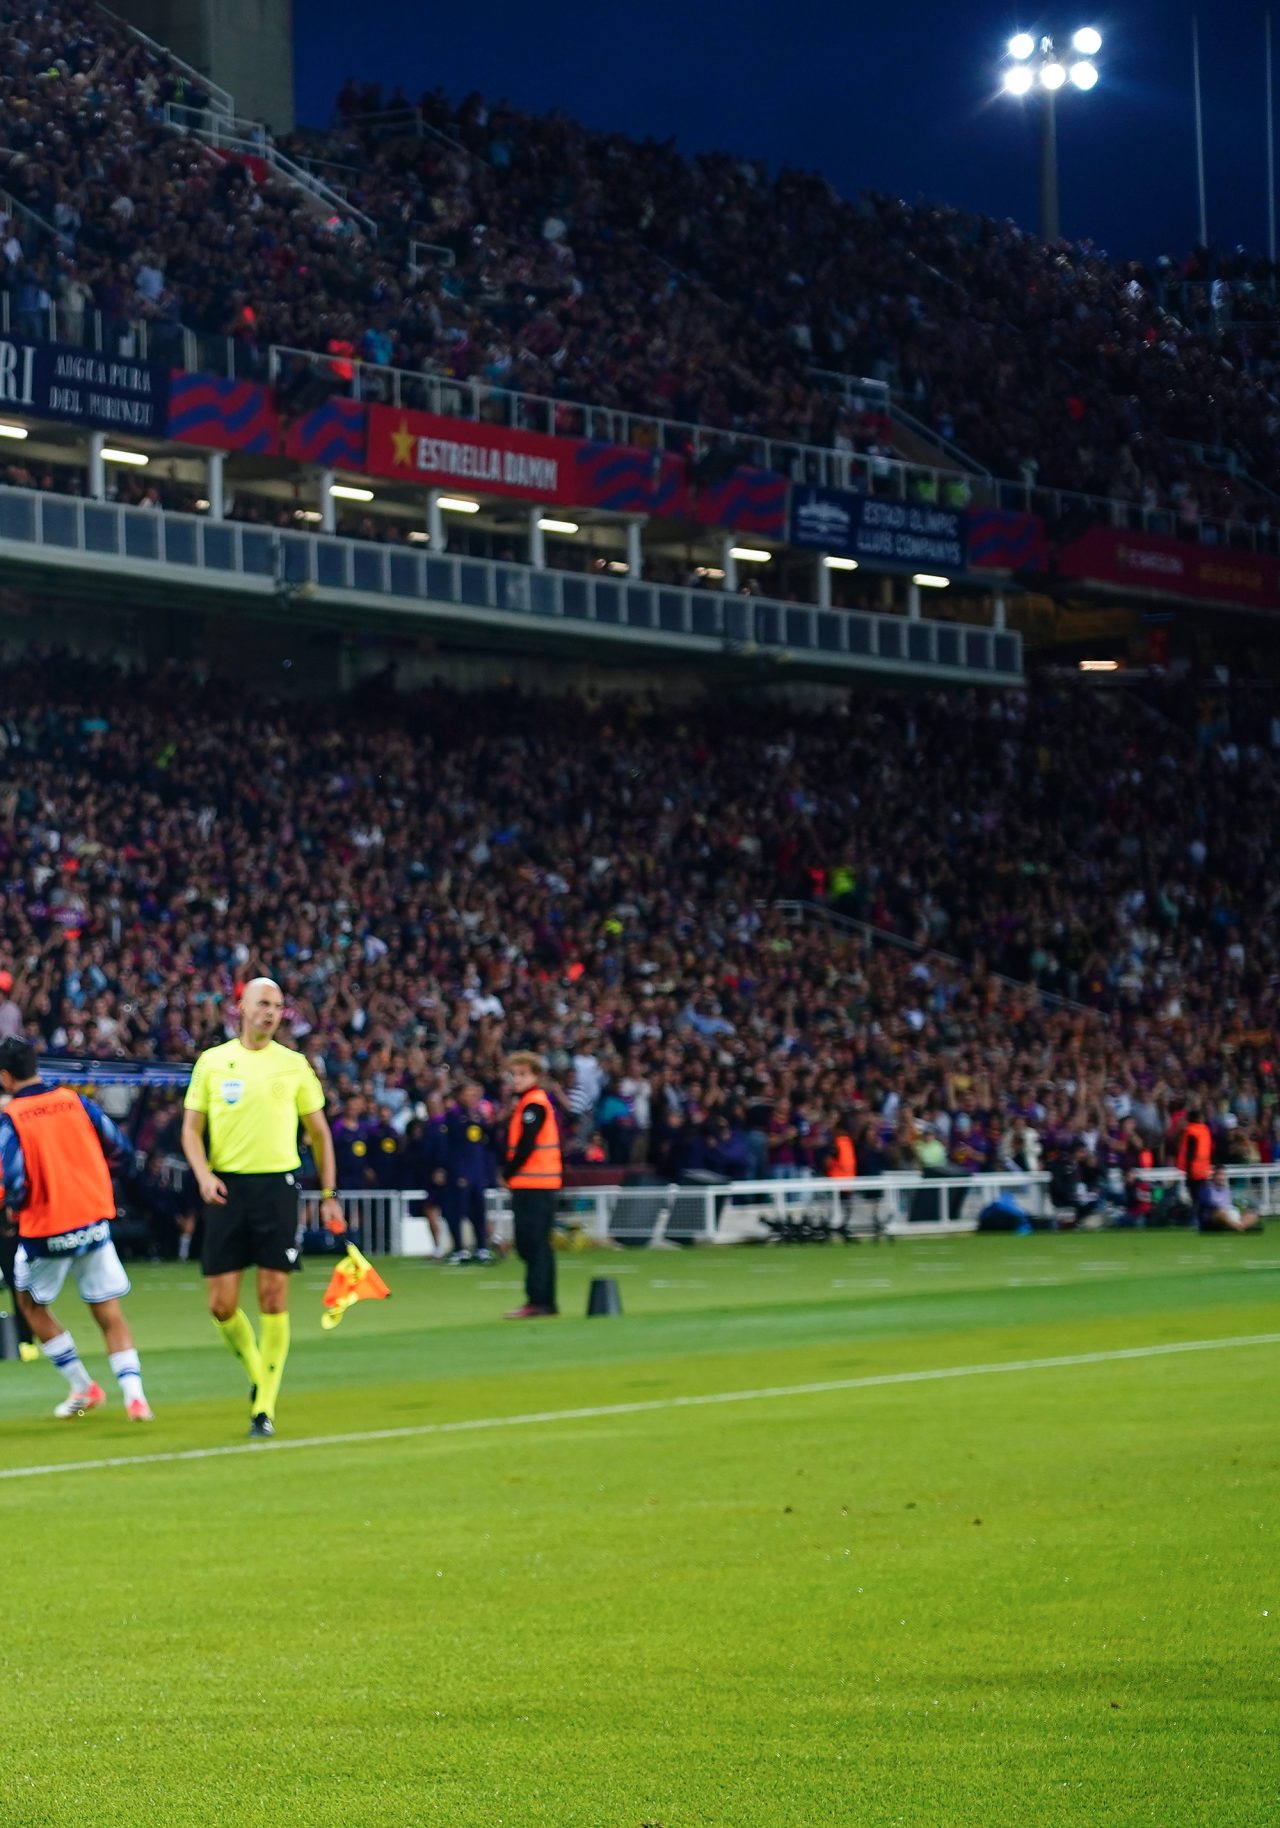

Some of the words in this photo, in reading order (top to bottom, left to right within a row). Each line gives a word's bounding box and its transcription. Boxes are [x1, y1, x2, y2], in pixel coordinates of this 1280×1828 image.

[109, 362, 152, 393] PURA
[48, 384, 84, 414] DEL
[417, 435, 503, 482] ESTRELLA
[503, 450, 558, 492] DAMM
